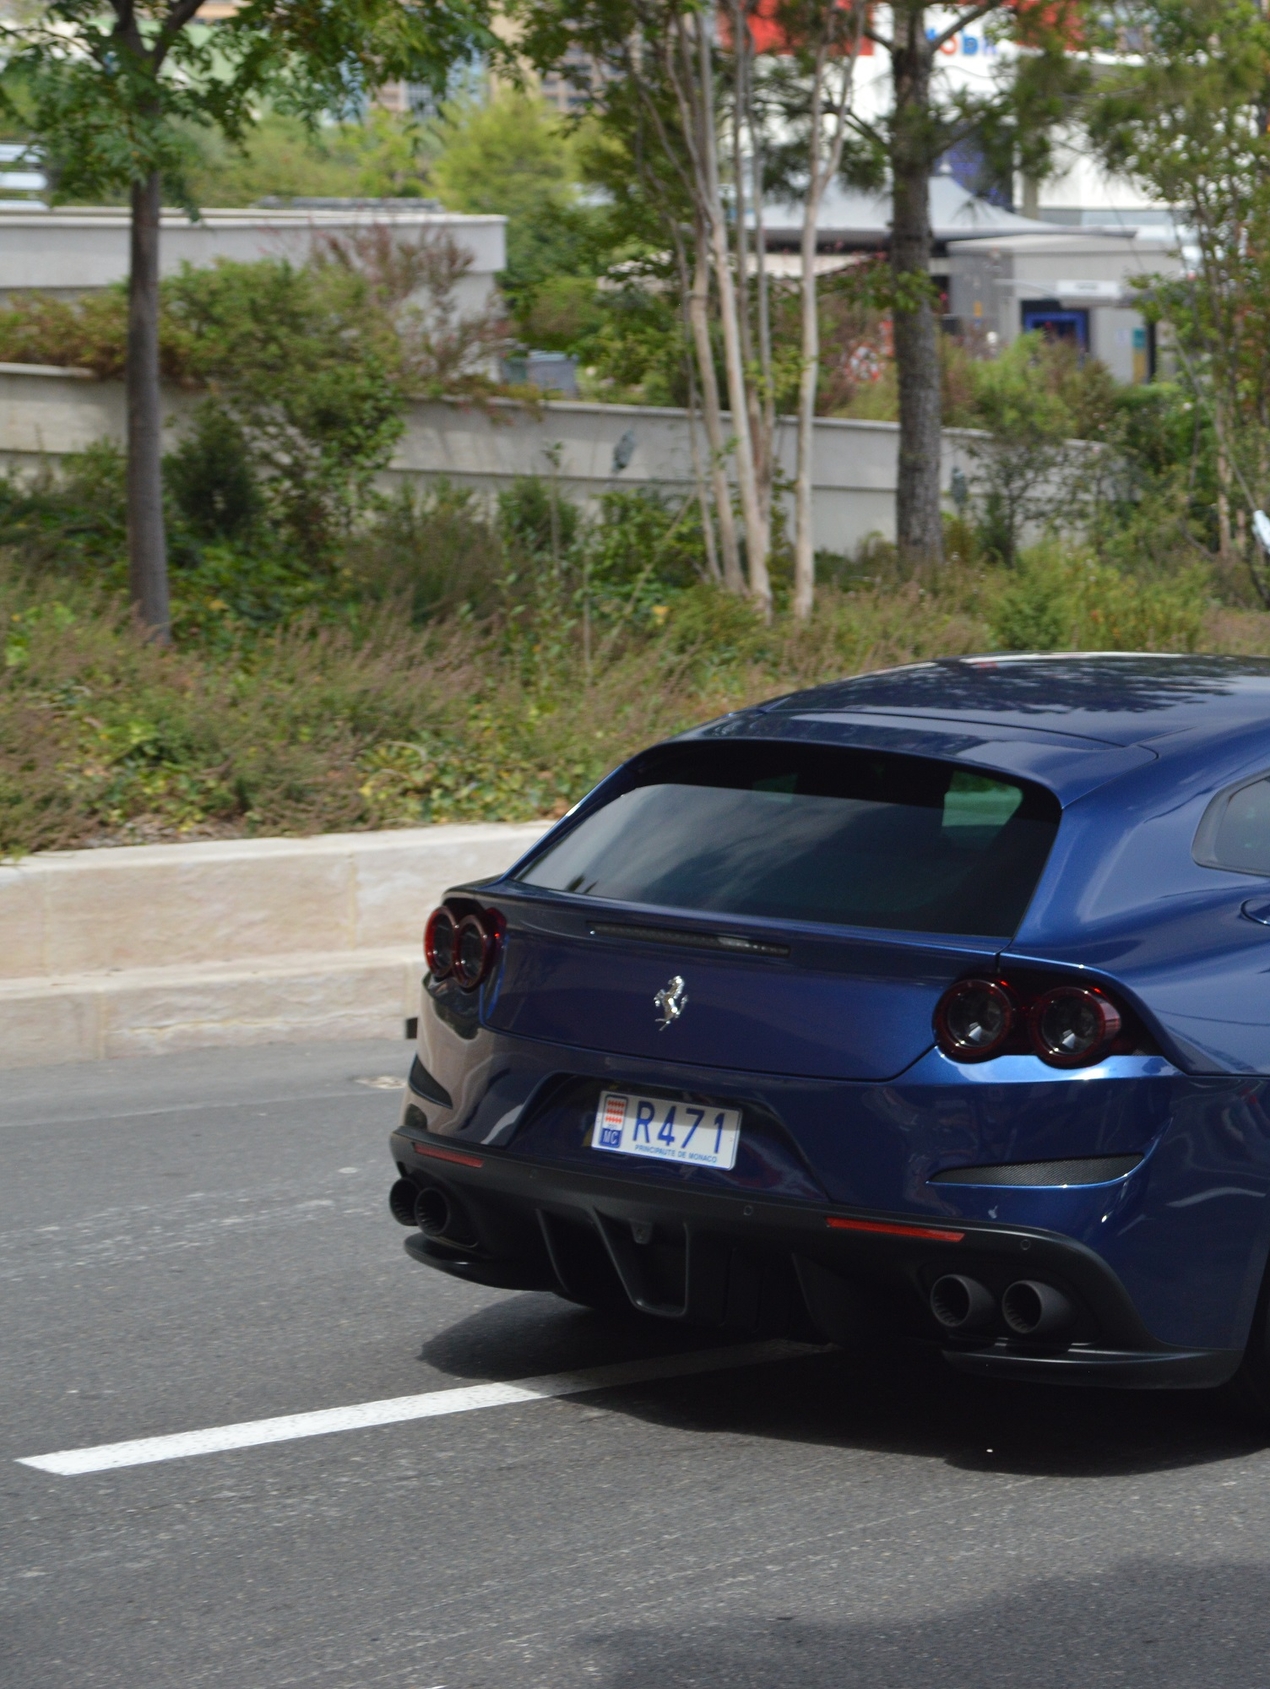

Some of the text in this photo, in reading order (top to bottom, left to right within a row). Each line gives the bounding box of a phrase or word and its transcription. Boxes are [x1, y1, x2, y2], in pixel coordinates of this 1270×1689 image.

[633, 1100, 725, 1154] R471
[602, 1130, 618, 1145] MC
[634, 1144, 718, 1164] PRINCIPAUTE DE MONACO
